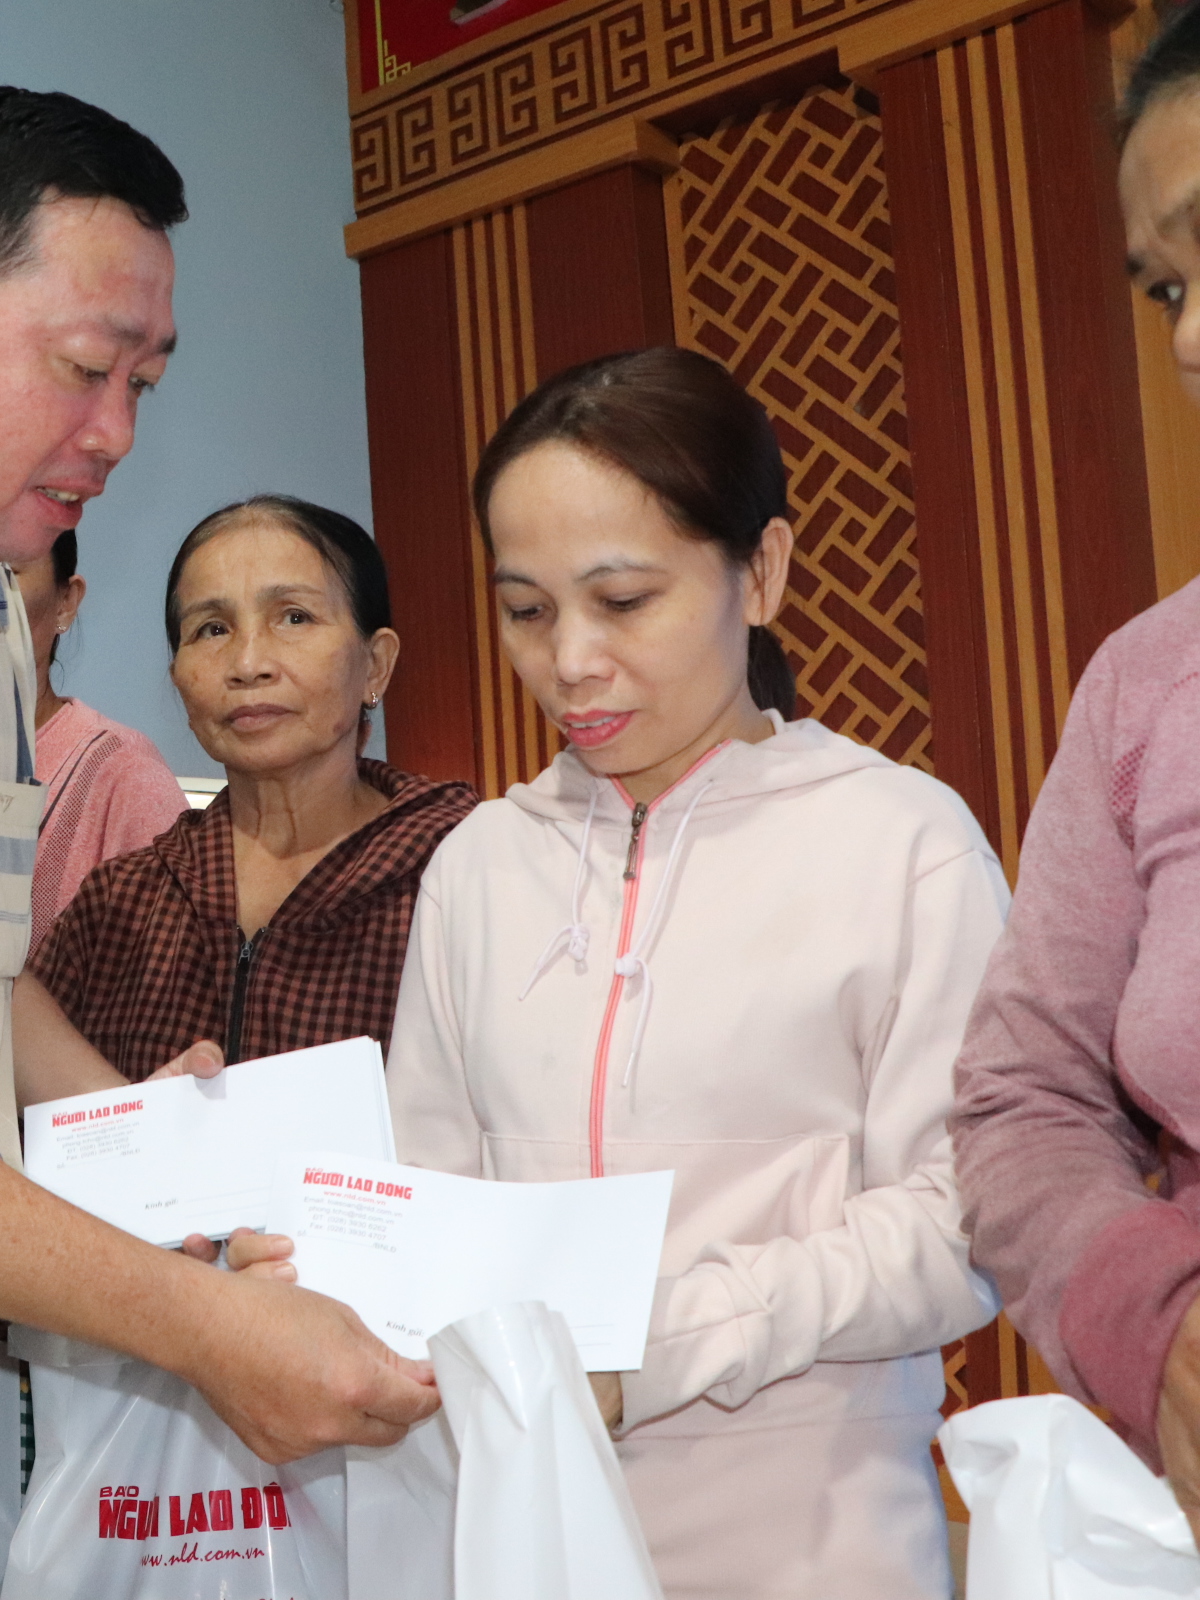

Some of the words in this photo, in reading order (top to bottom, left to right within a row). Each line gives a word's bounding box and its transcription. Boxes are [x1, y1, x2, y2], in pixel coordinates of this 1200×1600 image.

[89, 1107, 110, 1120] LAO
[347, 1176, 373, 1192] LAO
[324, 1190, 386, 1206] www.nld.com.vn
[169, 1489, 234, 1537] LAO
